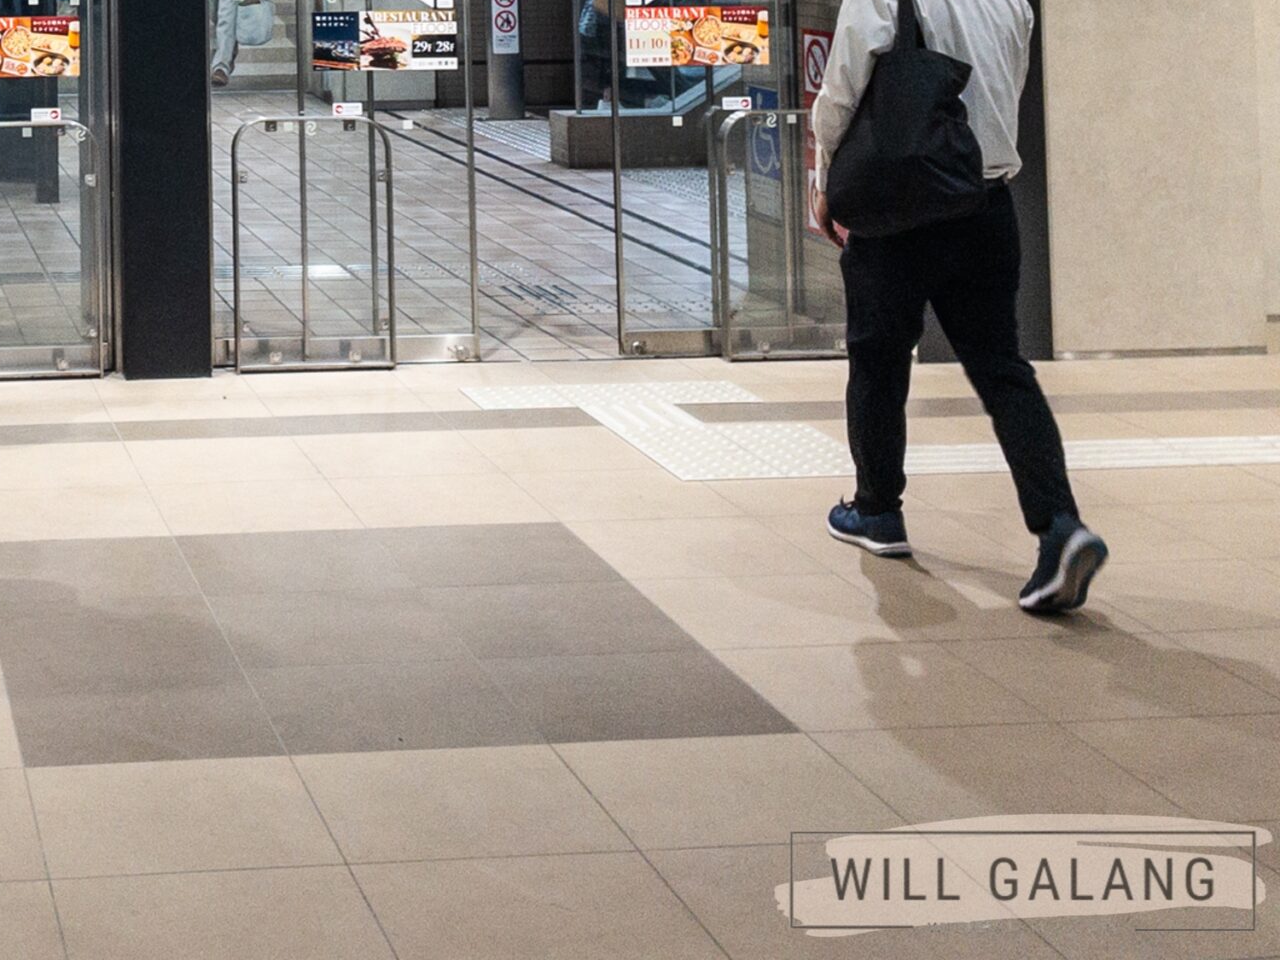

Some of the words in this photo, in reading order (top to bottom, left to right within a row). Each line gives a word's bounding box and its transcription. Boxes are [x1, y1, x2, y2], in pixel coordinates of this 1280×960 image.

[375, 10, 455, 22] RESTAURANT
[626, 7, 705, 18] RESTAURANT
[413, 22, 455, 34] FLOOR
[627, 19, 669, 31] FLOOR
